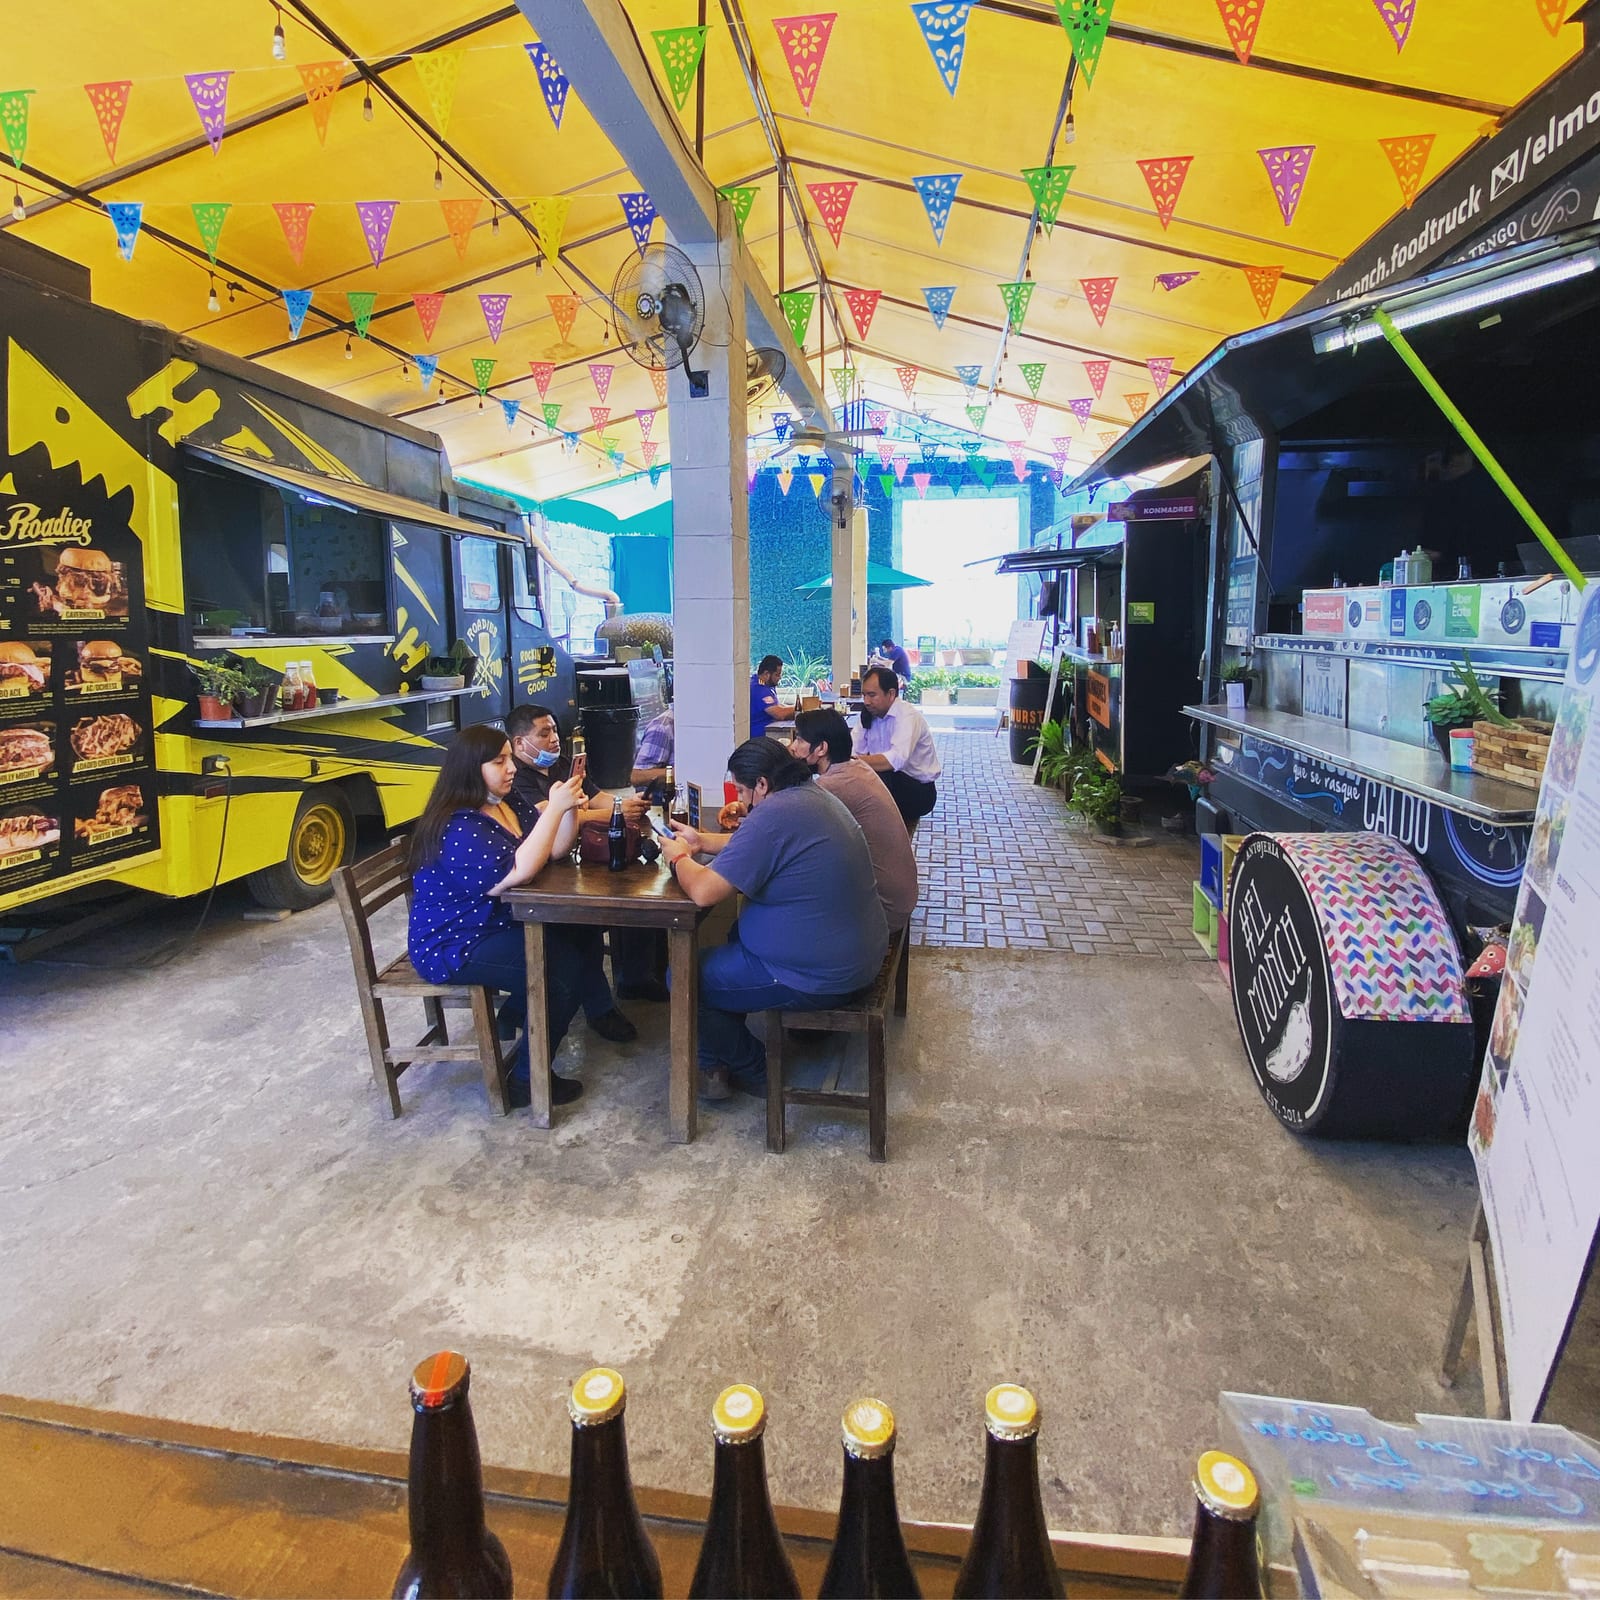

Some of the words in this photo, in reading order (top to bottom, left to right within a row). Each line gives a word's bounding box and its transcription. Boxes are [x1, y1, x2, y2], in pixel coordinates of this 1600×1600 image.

[1468, 221, 1518, 258] TENGO
[0, 503, 92, 546] Roadies
[1143, 505, 1194, 515] KONMADRES
[1293, 763, 1308, 783] que
[1310, 771, 1321, 785] se
[1324, 776, 1360, 803] rasque
[1364, 780, 1430, 854] CALDO
[1247, 904, 1307, 1044] MONCH
